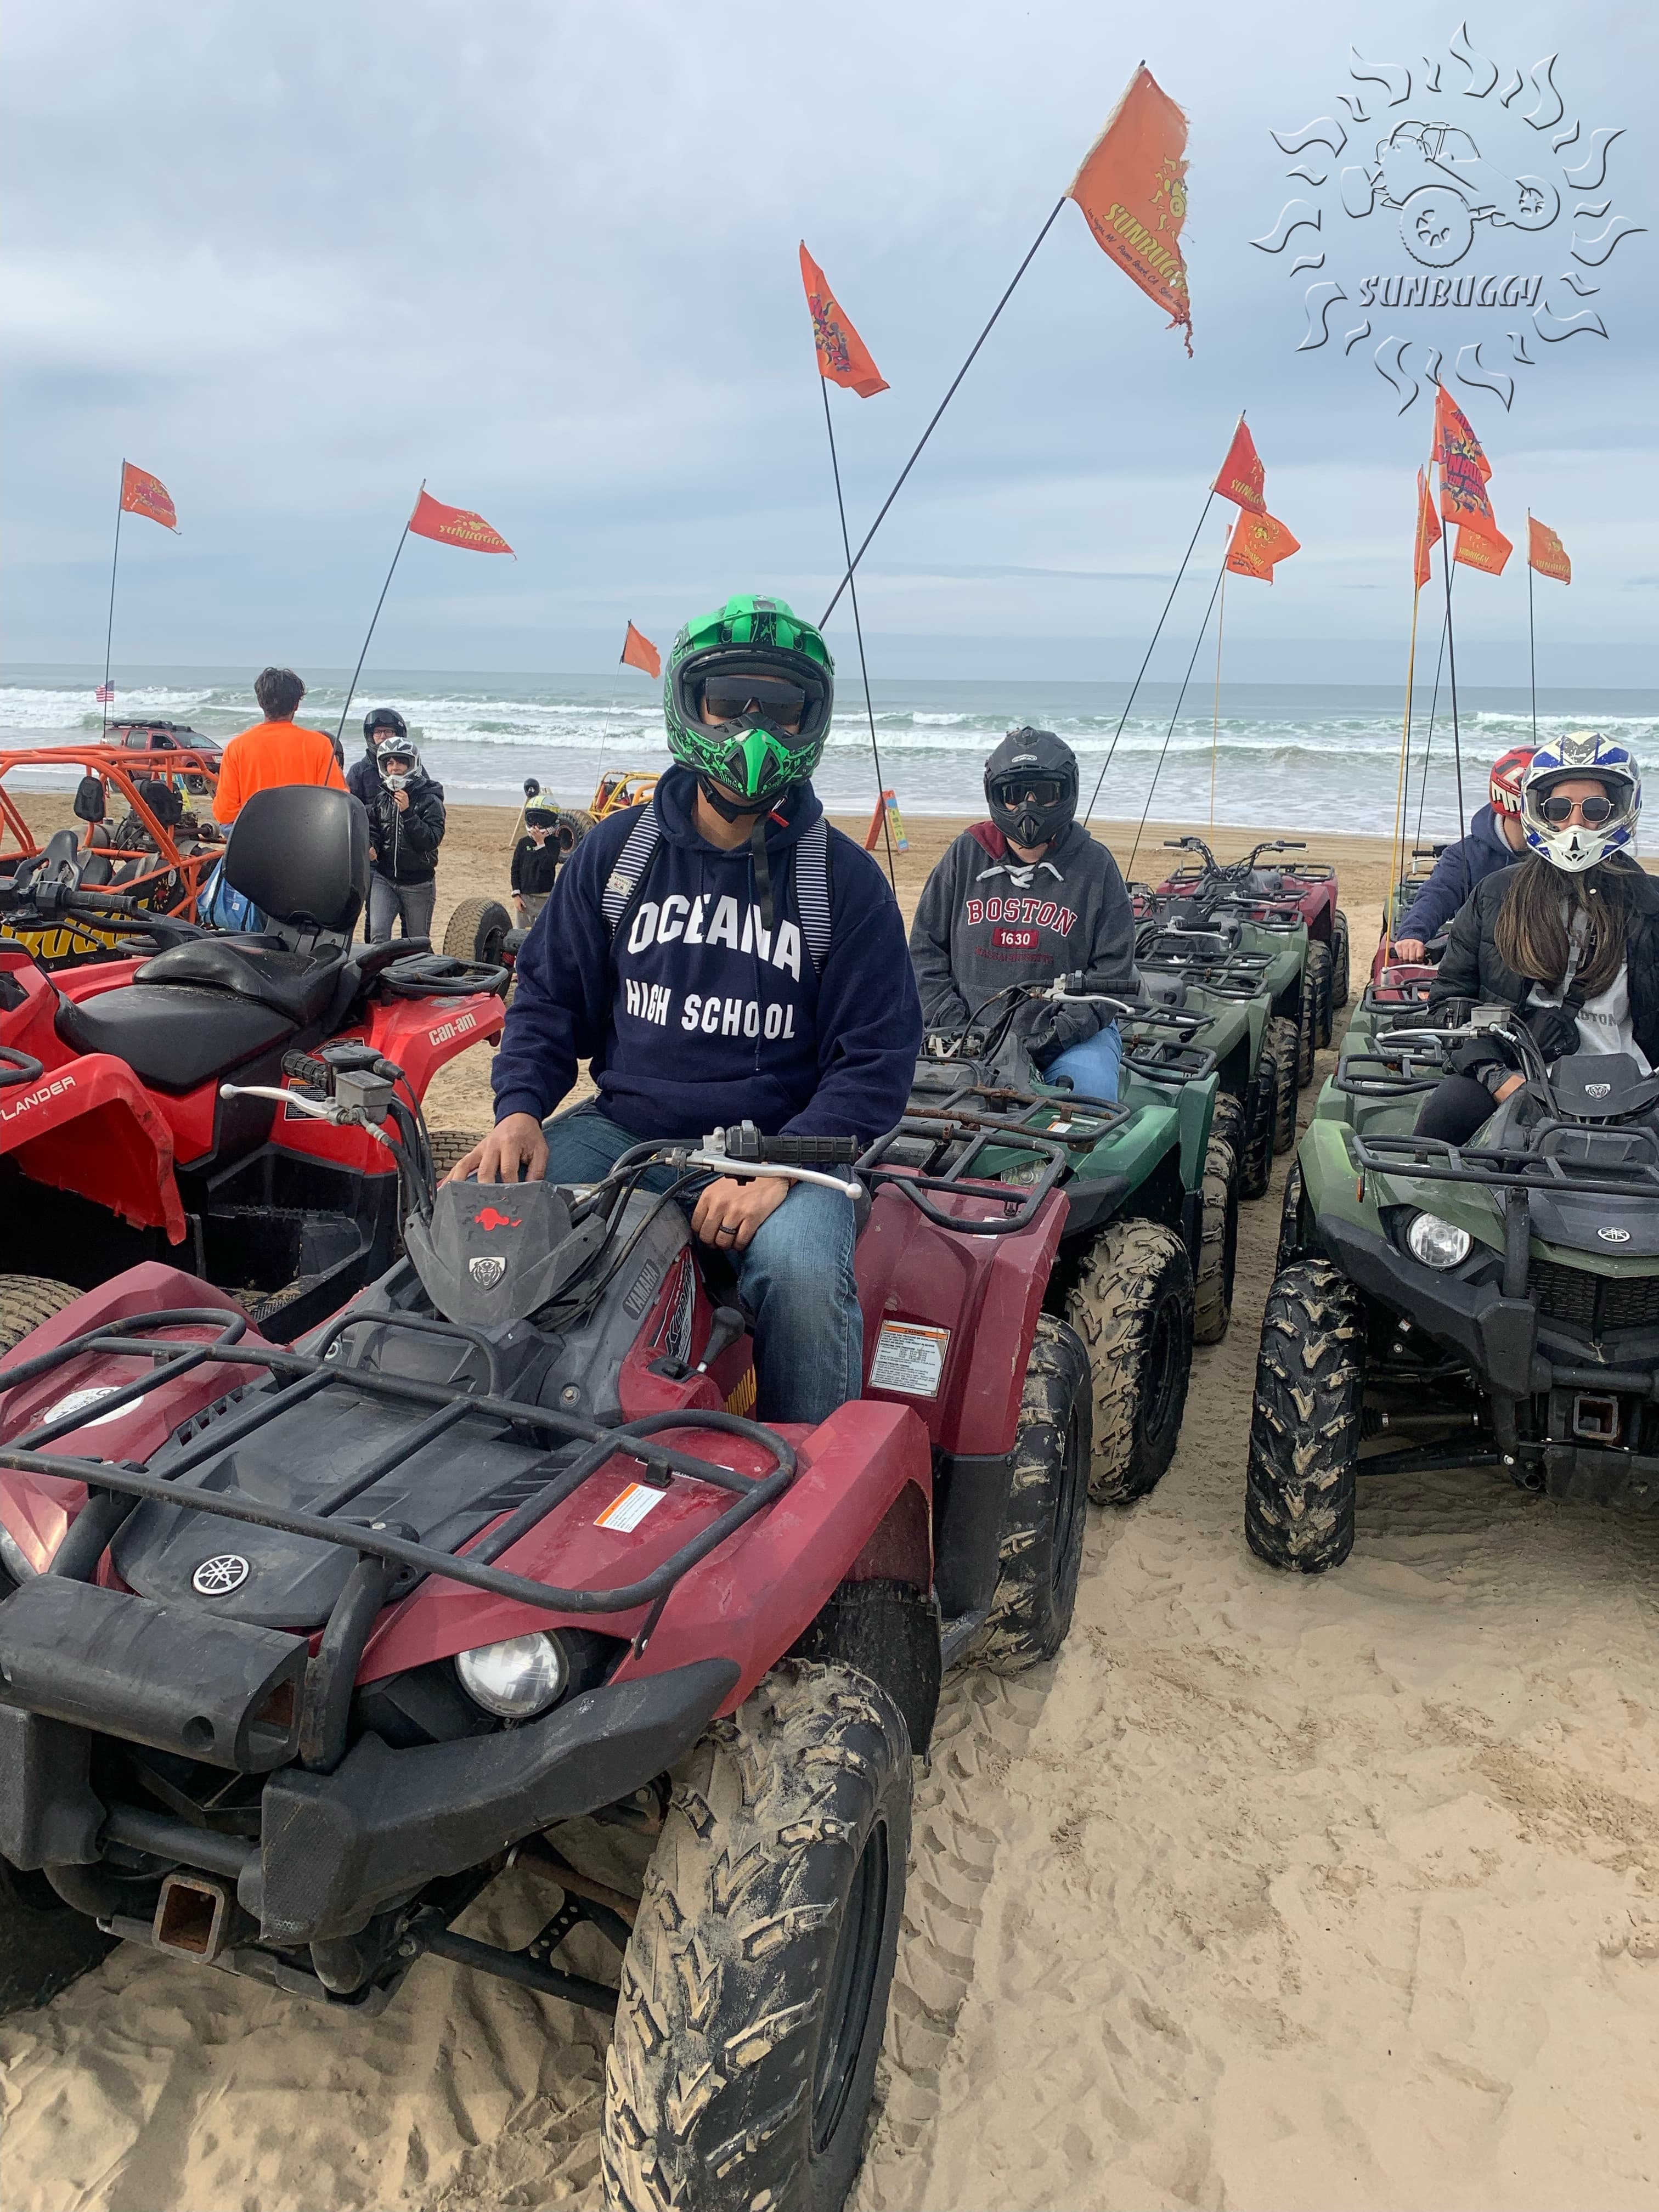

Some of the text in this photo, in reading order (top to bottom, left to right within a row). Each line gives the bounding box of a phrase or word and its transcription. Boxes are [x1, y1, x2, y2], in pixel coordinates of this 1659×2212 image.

[627, 894, 801, 983] OCEANA
[966, 897, 1078, 938] BOSTON
[1001, 932, 1030, 945] 1630
[428, 1013, 477, 1046] can-am
[625, 978, 795, 1039] HIGH SCHOOL
[0, 1076, 76, 1120] LANDER
[625, 1263, 659, 1314] YAMAHA
